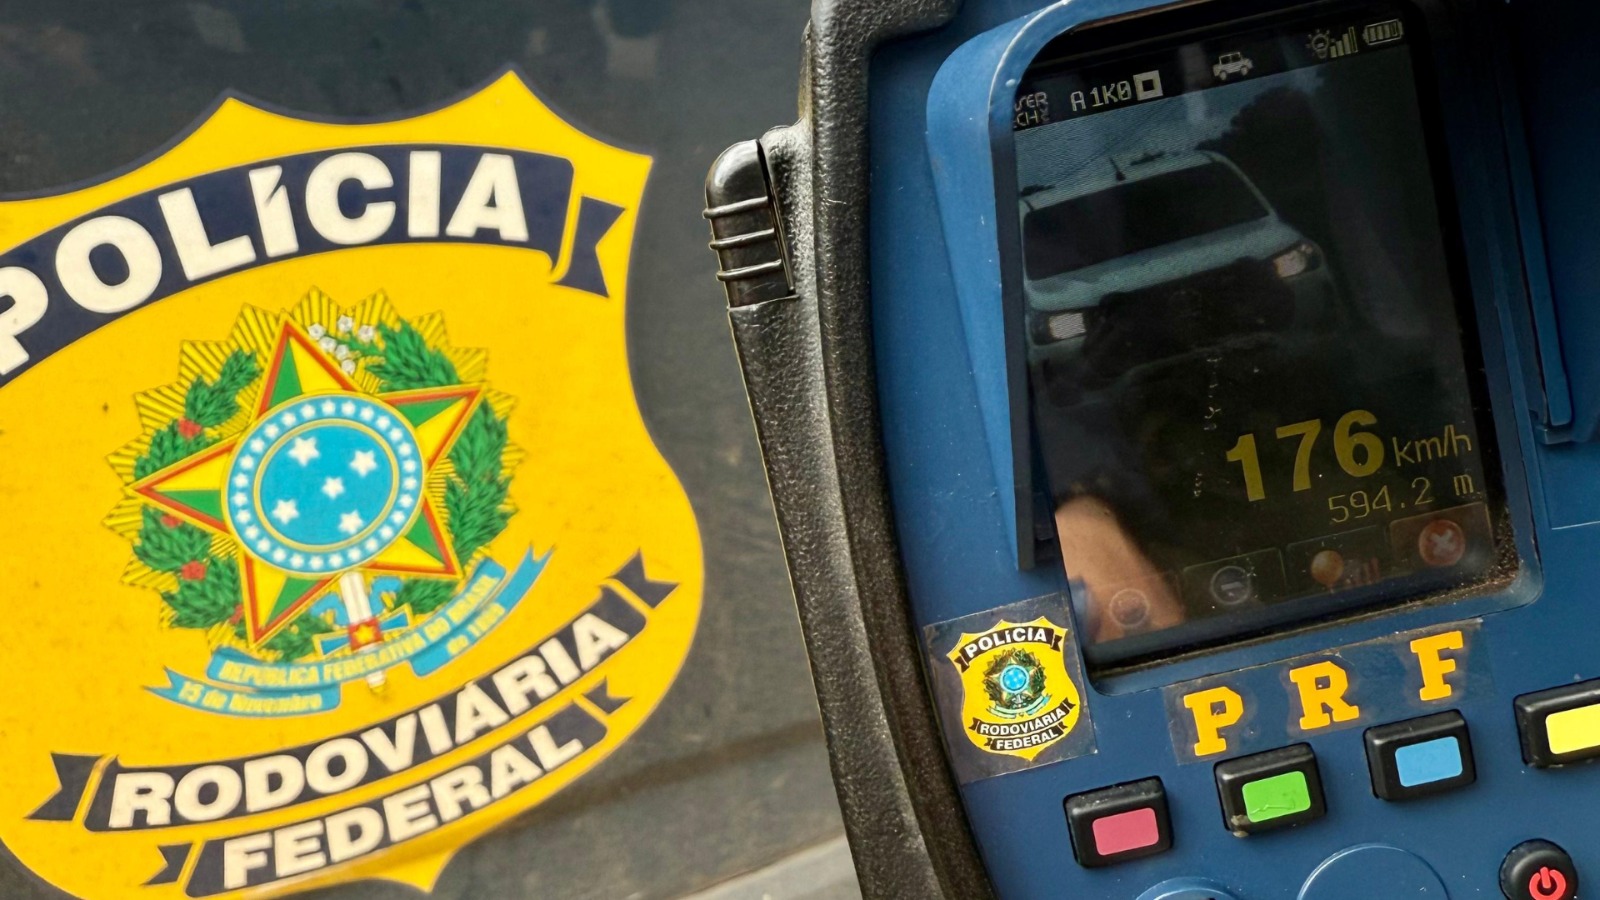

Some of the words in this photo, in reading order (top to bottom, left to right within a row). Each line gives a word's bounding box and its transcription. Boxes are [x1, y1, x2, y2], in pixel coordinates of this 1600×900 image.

[1070, 90, 1086, 112] A
[0, 150, 529, 375] POLÍCIA
[1225, 409, 1385, 502] 176
[1392, 424, 1472, 467] km/h
[1328, 476, 1433, 524] 594.2
[1453, 473, 1474, 496] m
[324, 631, 427, 676] FEDERATIVA
[424, 616, 450, 643] DO
[964, 627, 1047, 658] POLÍCIA
[108, 611, 630, 829] RODOVIÁRIA
[177, 680, 201, 701] 15
[202, 687, 227, 709] de
[1183, 686, 1244, 757] P
[1289, 660, 1360, 731] R
[1410, 630, 1464, 702] F
[979, 707, 1067, 736] RODOVIÁRIA
[996, 729, 1059, 750] FEDERAL
[223, 723, 584, 889] FEDERAL
